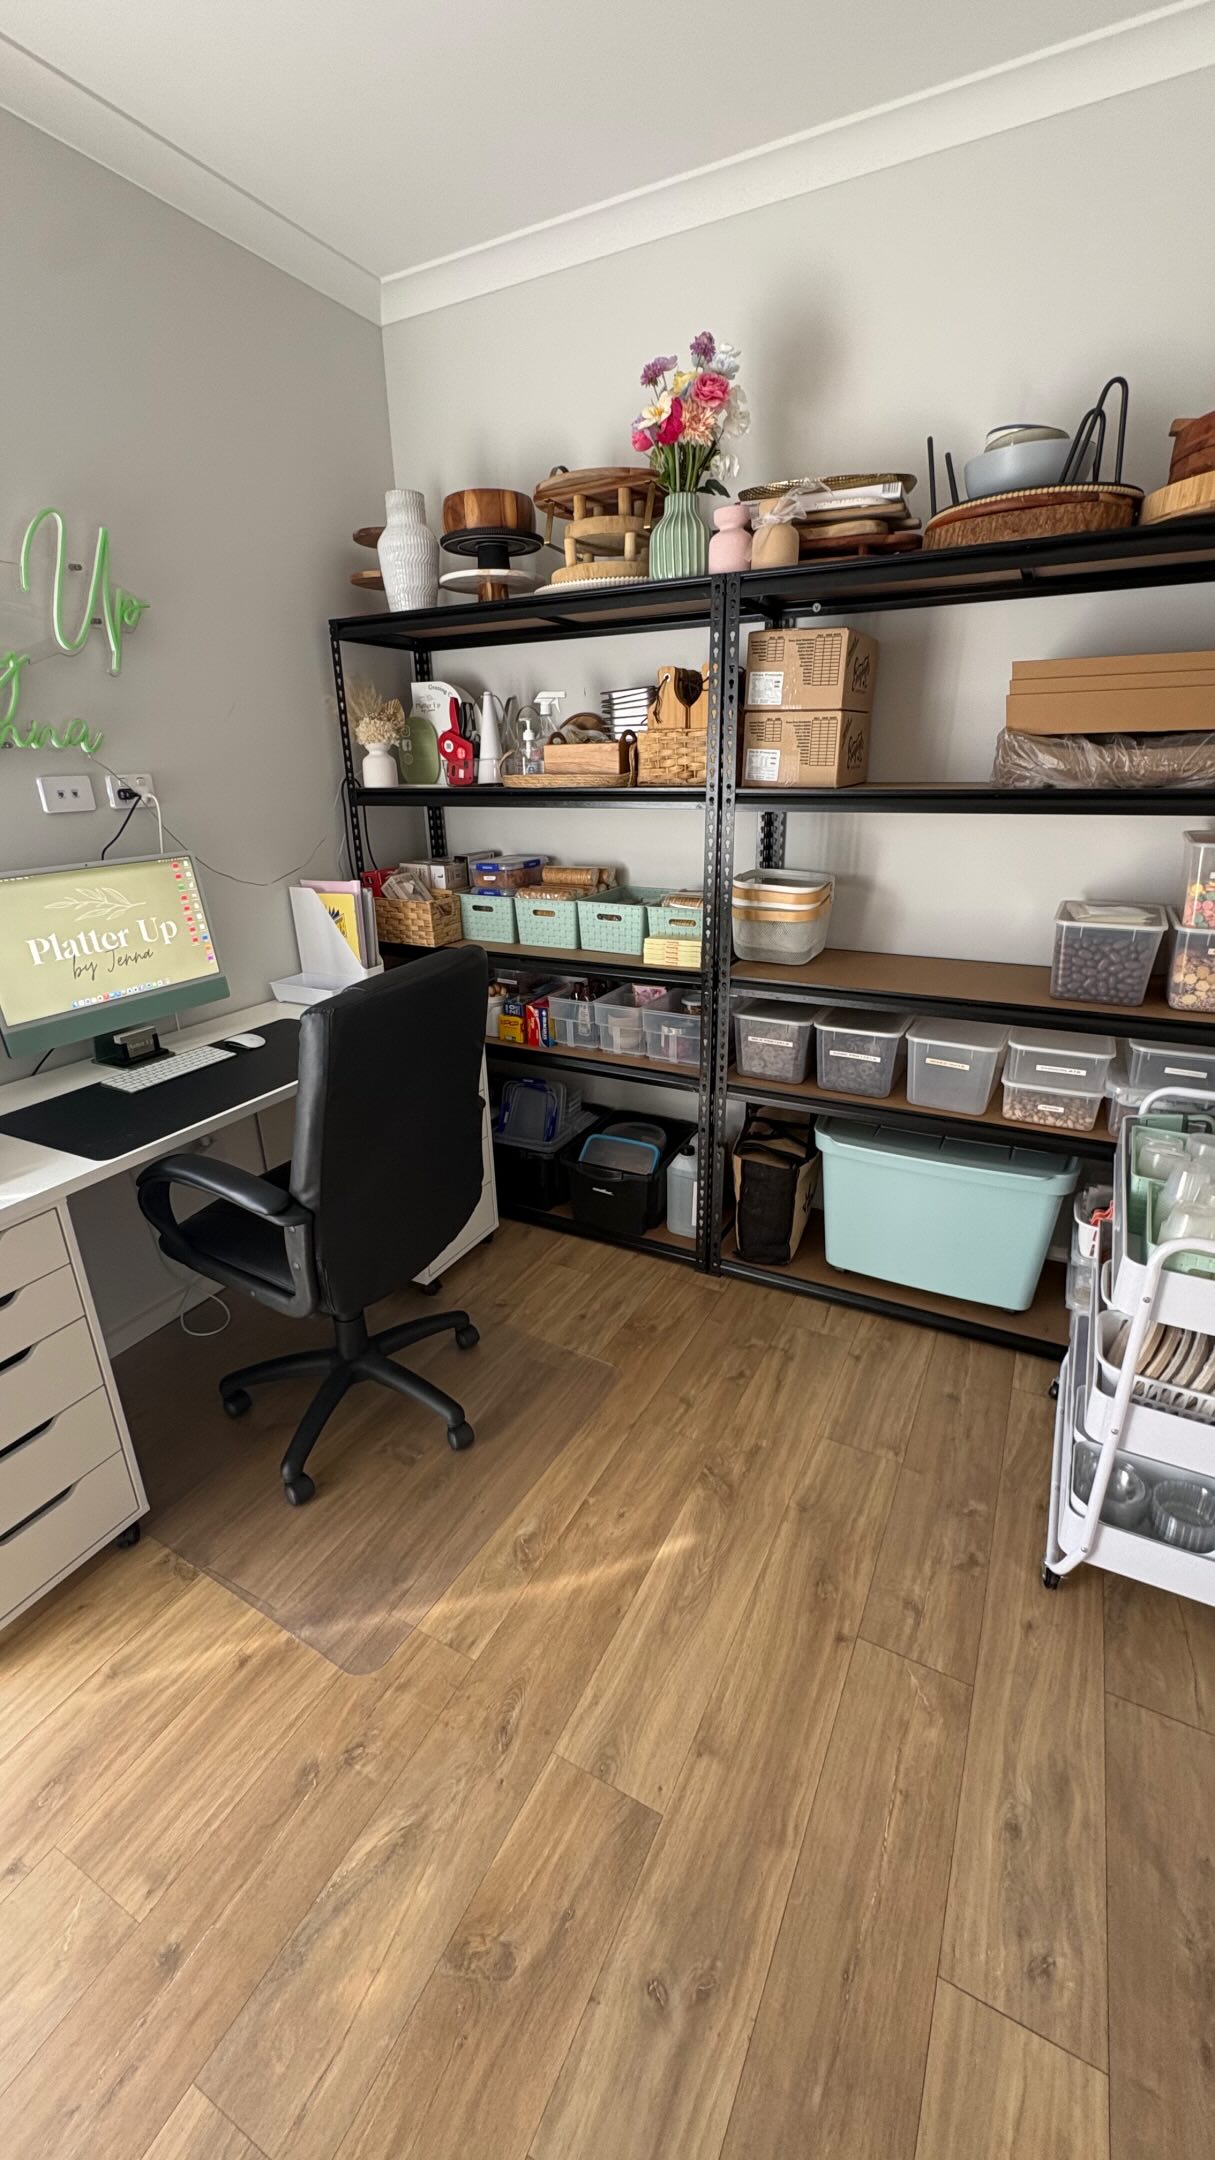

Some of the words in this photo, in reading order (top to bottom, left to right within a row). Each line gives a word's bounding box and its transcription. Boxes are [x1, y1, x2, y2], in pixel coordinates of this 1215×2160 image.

[20, 506, 150, 673] Up
[0, 718, 104, 753] nna
[26, 927, 129, 966] Platter
[136, 916, 178, 945] Up
[72, 955, 98, 981] by
[104, 947, 154, 974] Jenna
